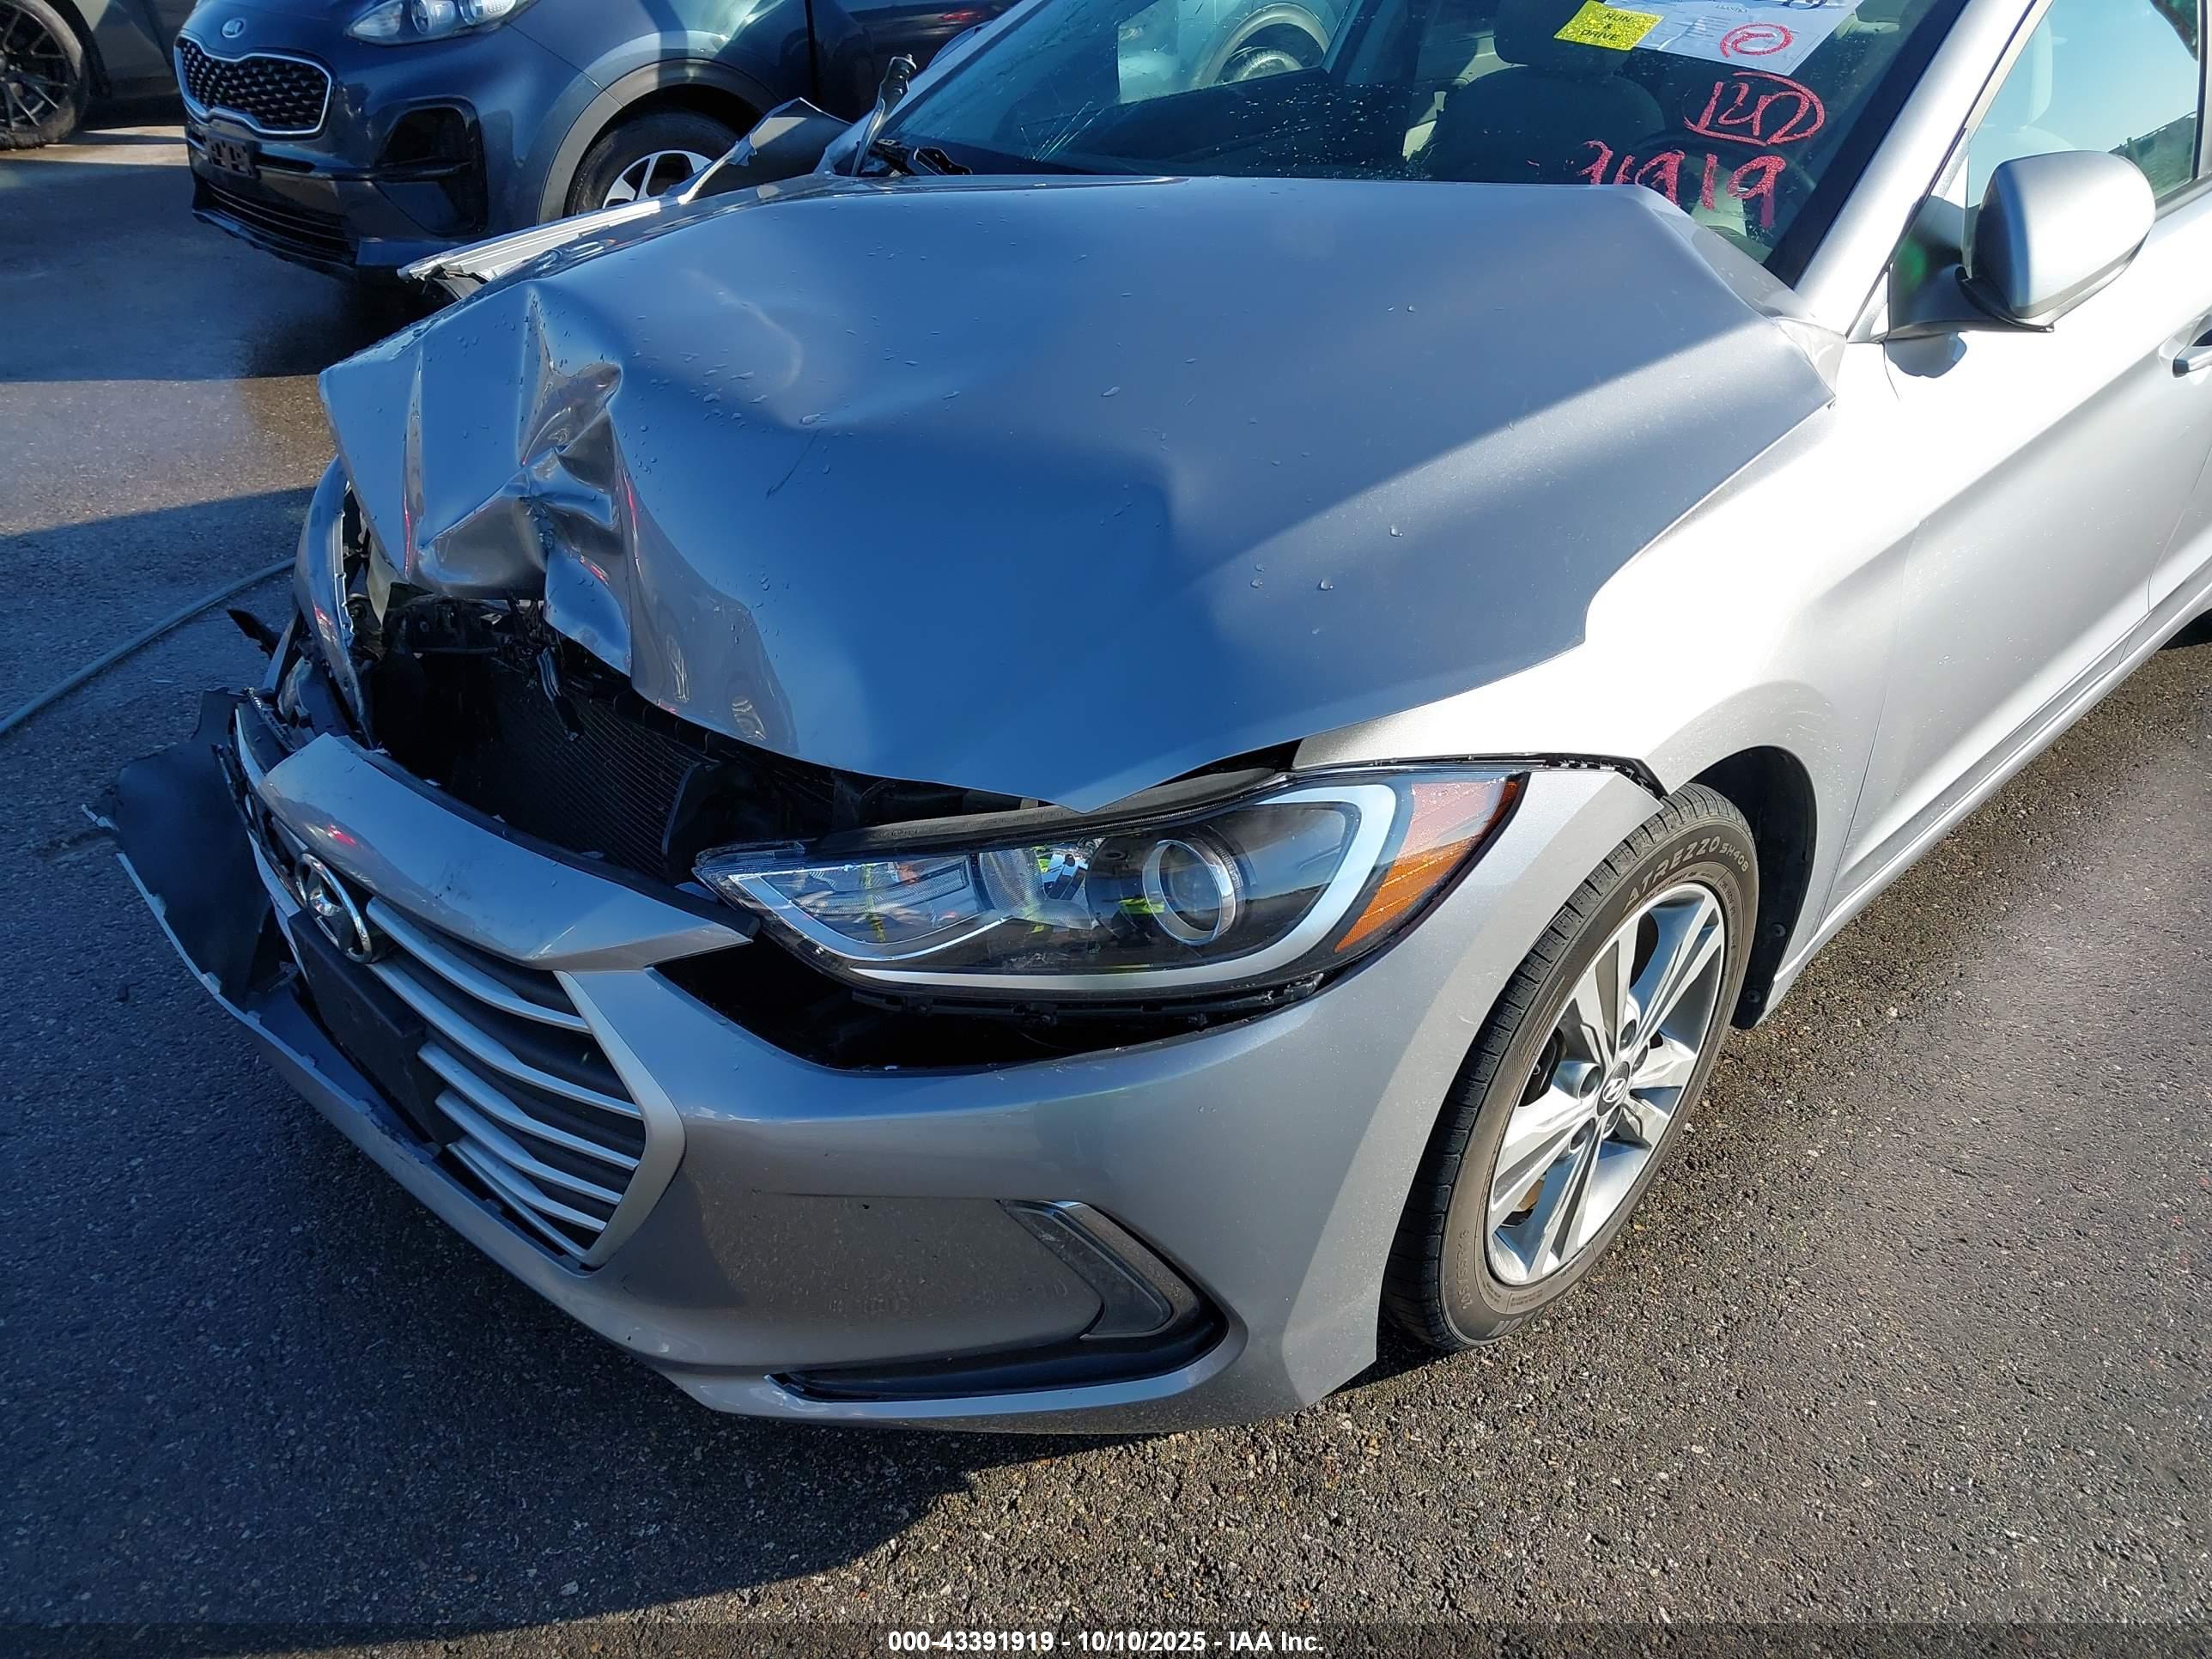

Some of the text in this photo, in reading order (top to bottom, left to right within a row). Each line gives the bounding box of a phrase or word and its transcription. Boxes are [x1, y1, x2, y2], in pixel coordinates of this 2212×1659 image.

[1603, 11, 1633, 23] RUN
[1580, 29, 1620, 42] DRIVE
[1622, 836, 1721, 914] ATREZZO
[1718, 842, 1749, 872] SH408
